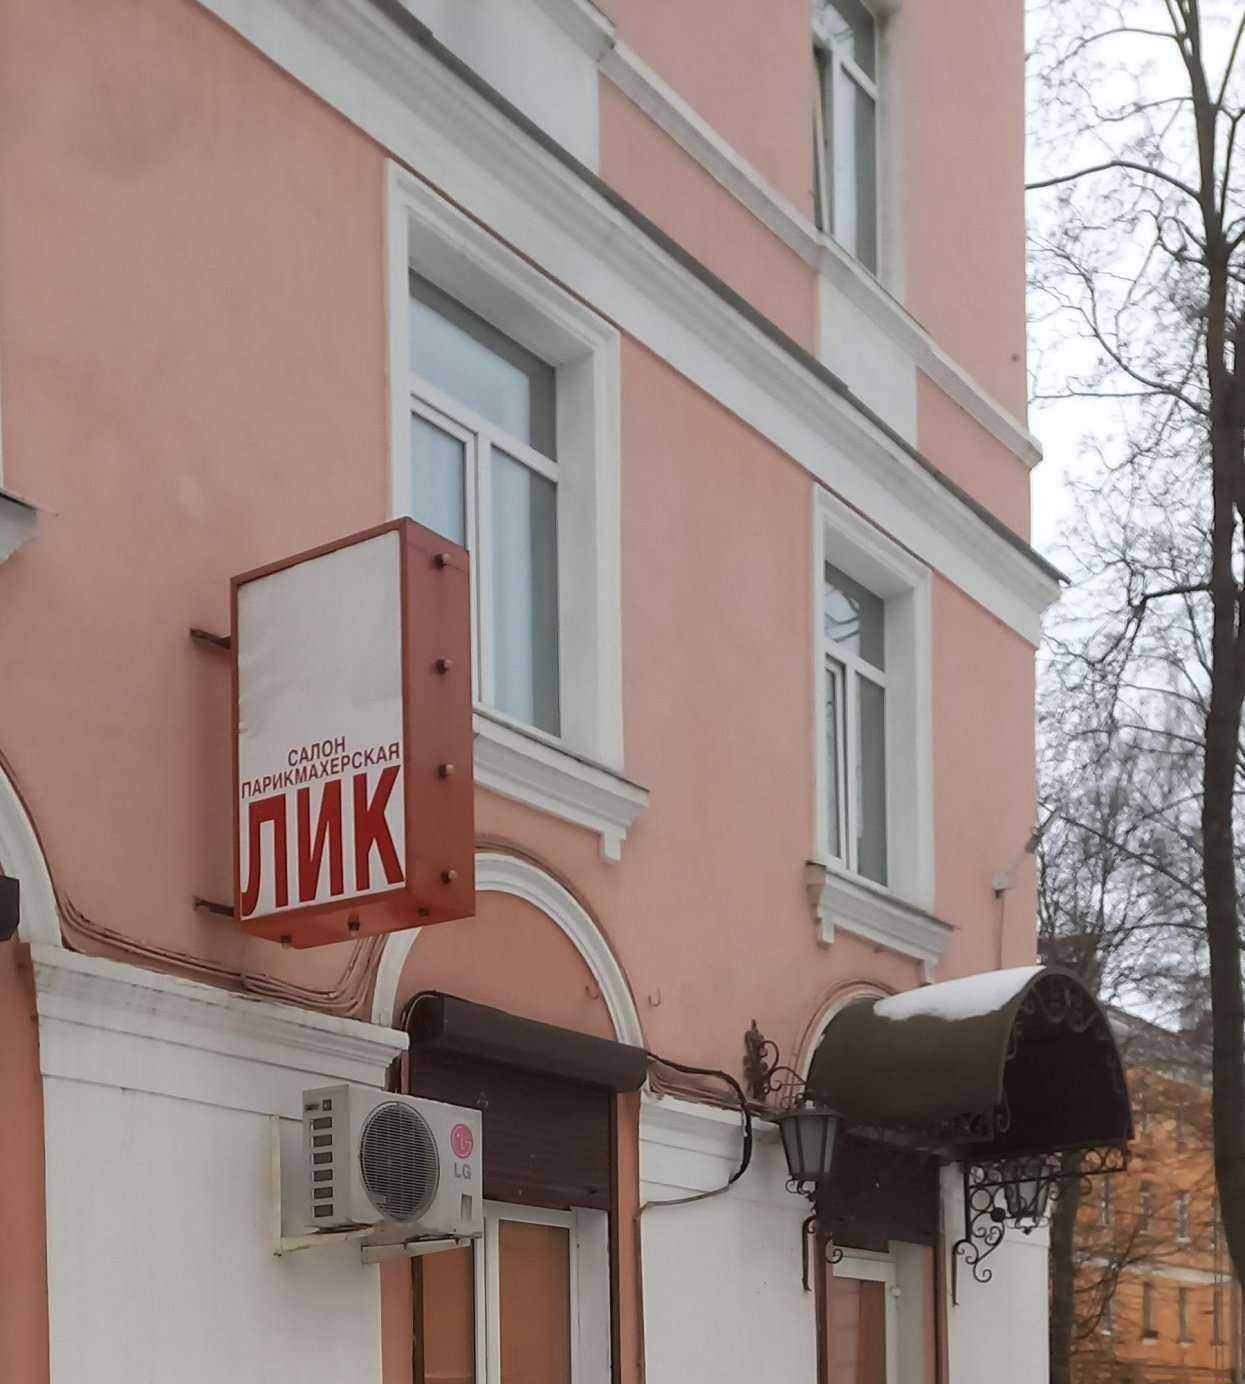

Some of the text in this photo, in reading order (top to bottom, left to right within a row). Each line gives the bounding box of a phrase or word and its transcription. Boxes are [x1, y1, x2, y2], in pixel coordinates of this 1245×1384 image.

[241, 742, 400, 799] ПАРИКМАХЕРСКАЯ
[287, 736, 346, 767] САЛОН
[241, 765, 405, 917] ЛИК
[454, 1163, 471, 1179] LG
